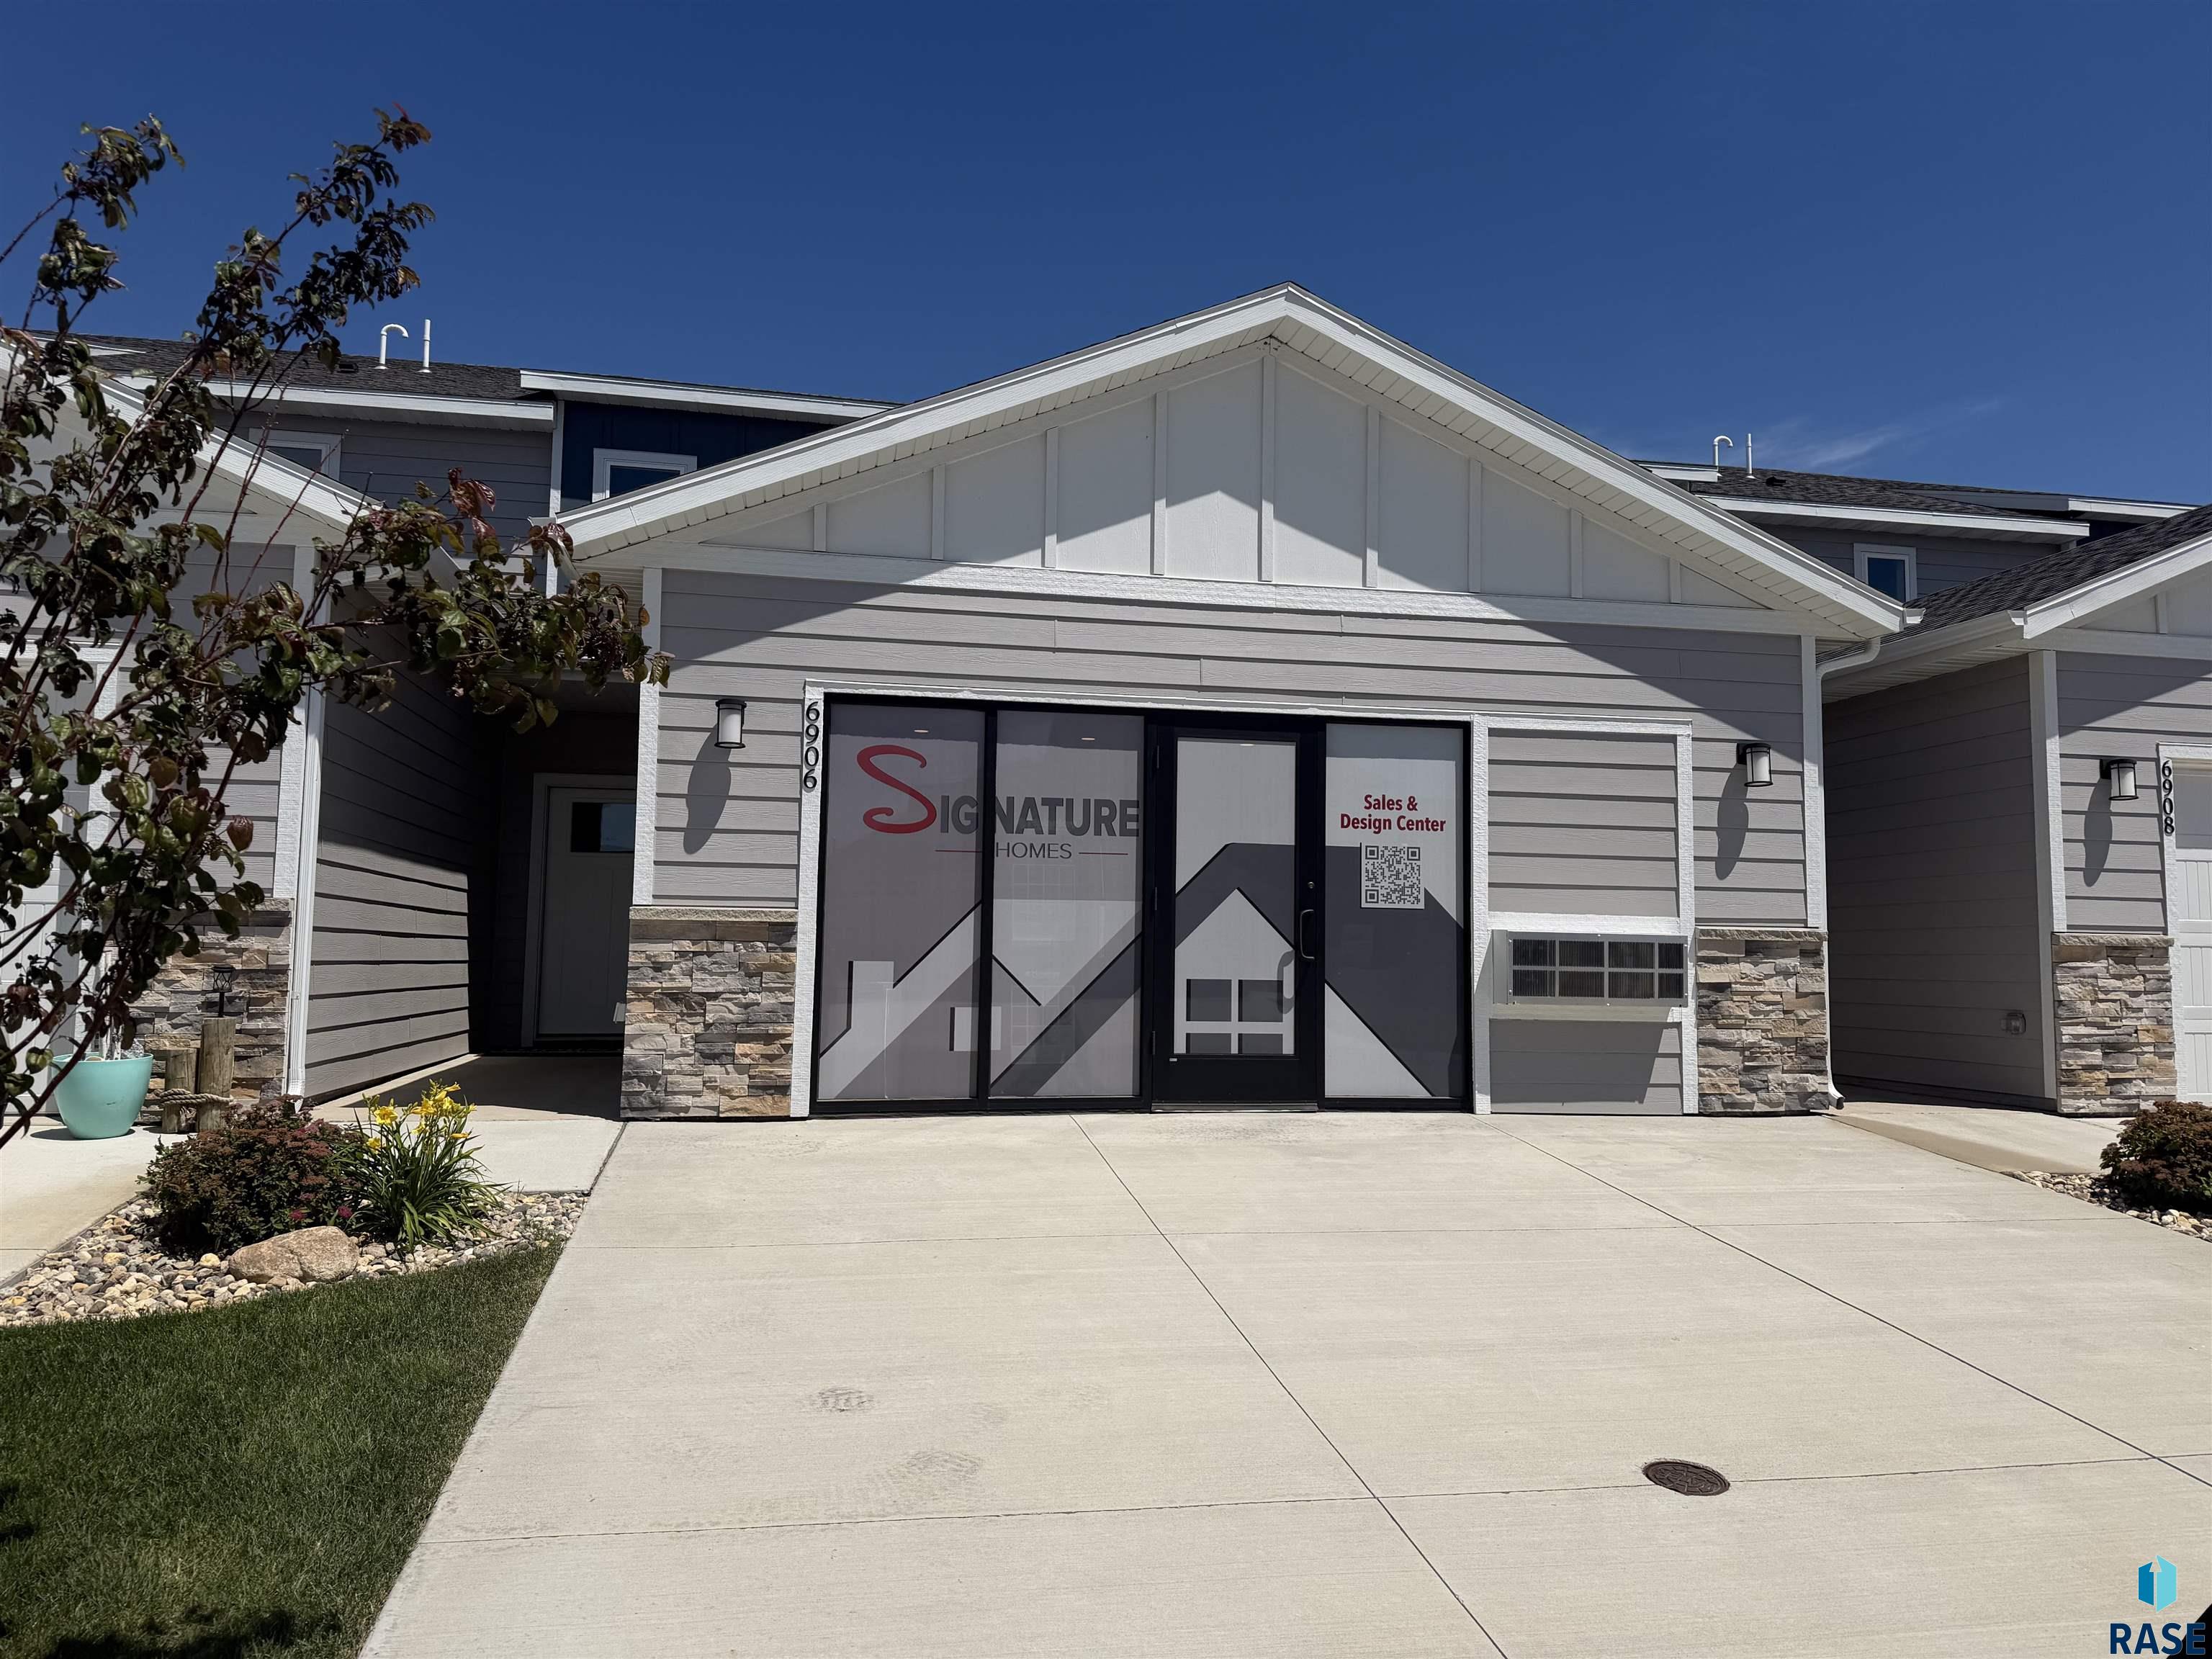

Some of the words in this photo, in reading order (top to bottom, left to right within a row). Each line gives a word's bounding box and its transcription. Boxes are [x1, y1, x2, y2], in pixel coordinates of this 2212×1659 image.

[802, 701, 821, 789] 6906
[856, 744, 1141, 837] SIGNATURE
[1364, 794, 1403, 811] Sales
[1406, 796, 1418, 811] &
[2162, 760, 2175, 835] 6908
[1340, 814, 1392, 835] Design
[1396, 815, 1446, 832] Center
[995, 842, 1072, 859] HOMES
